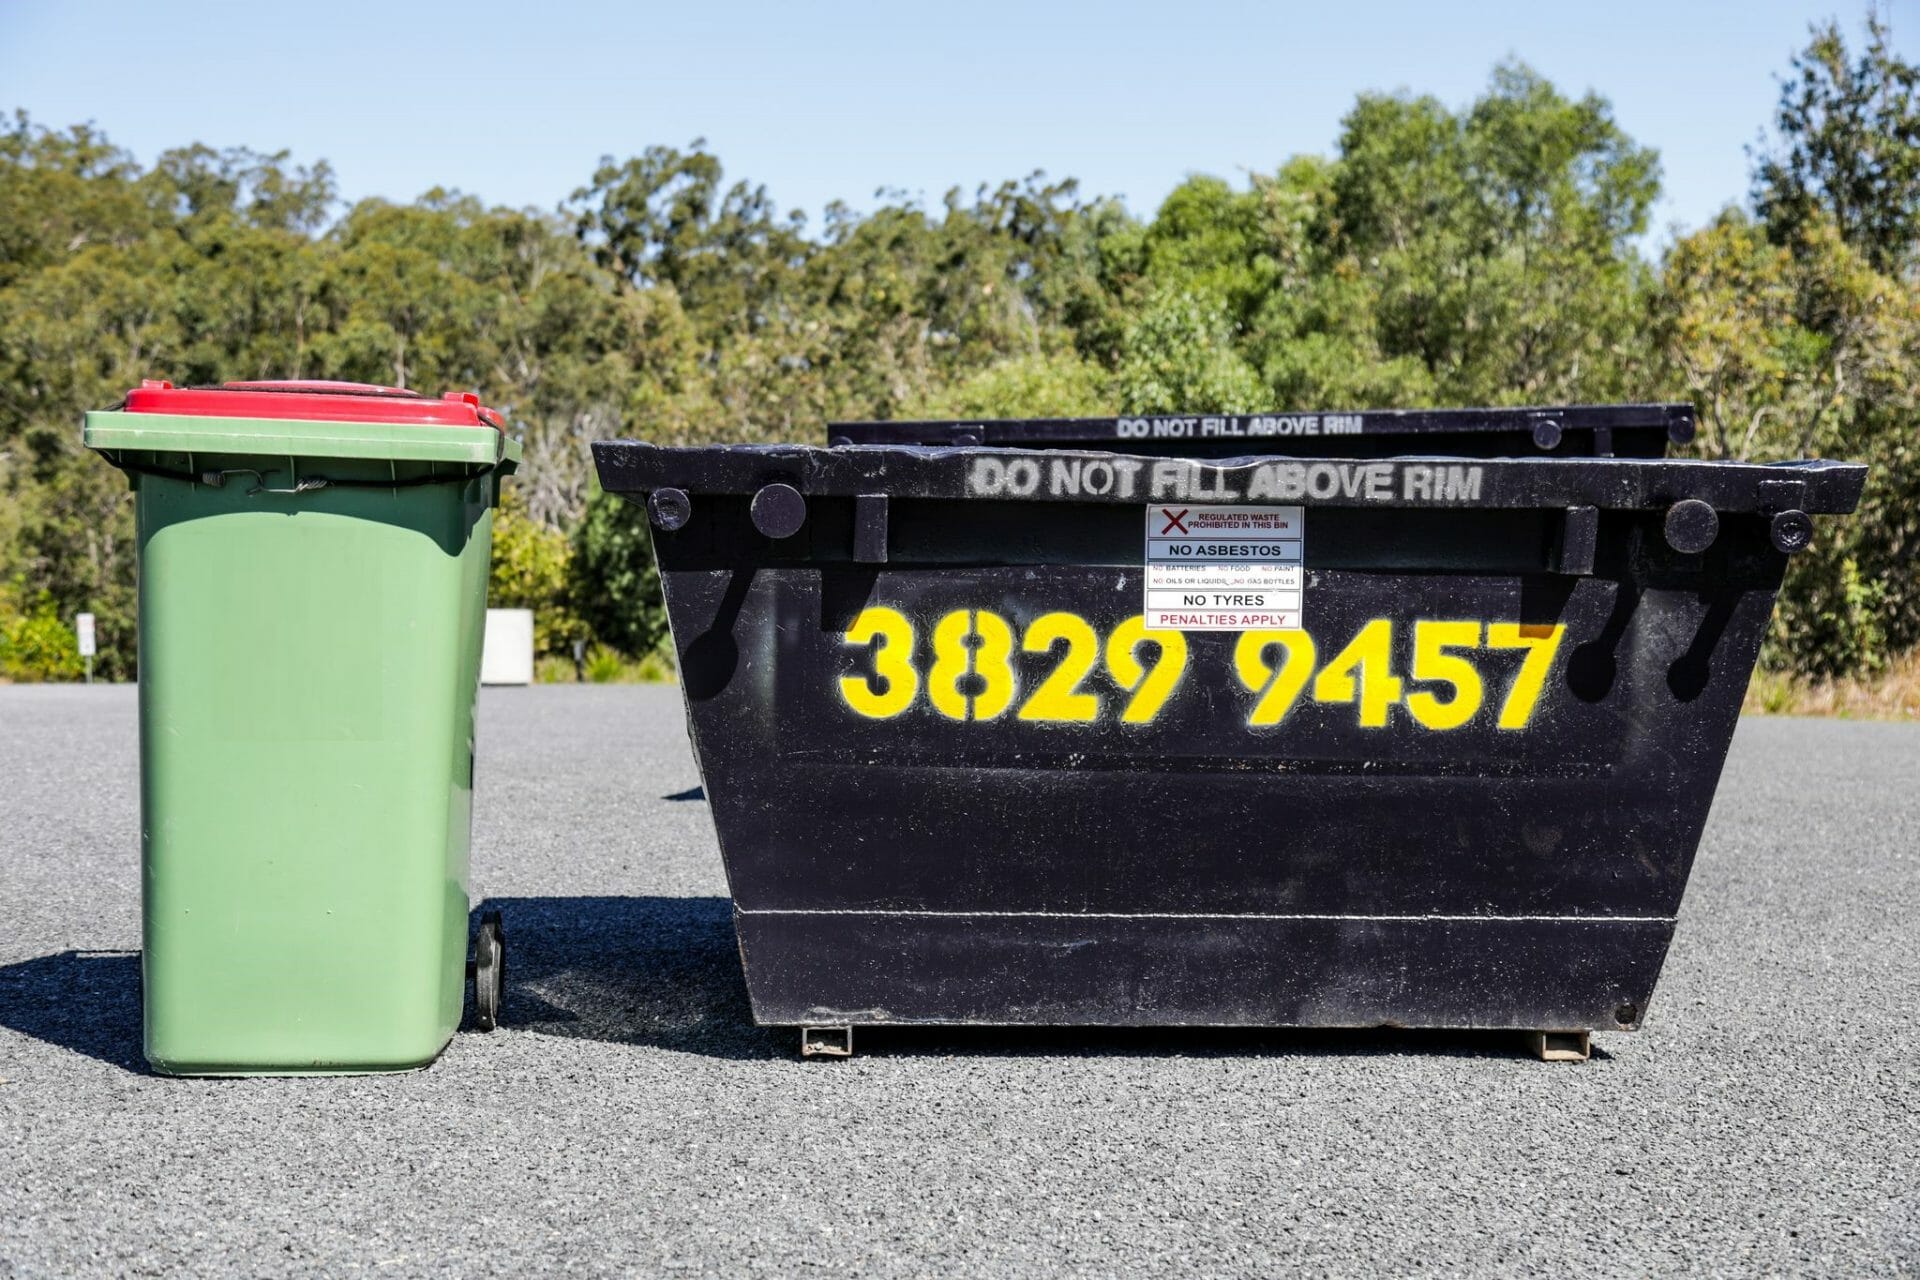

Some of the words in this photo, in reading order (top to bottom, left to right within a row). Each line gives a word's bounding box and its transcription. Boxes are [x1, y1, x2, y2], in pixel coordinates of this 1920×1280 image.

[1117, 419, 1149, 437] DO
[1153, 419, 1197, 437] NOT
[1201, 418, 1244, 436] FILL
[1247, 417, 1319, 435] ABOVE
[1323, 416, 1362, 434] RIM
[970, 457, 1039, 496] DO
[1051, 459, 1143, 498] NOT
[1153, 460, 1240, 499] FILL
[1249, 463, 1394, 500] ABOVE
[1404, 466, 1482, 500] RIM
[1188, 521, 1239, 529] PROHIBITED
[1169, 545, 1192, 556] NO
[1196, 545, 1281, 556] ASBESTOS
[1183, 595, 1206, 606] NO
[1213, 595, 1265, 606] TYRES
[1160, 615, 1237, 625] PENALTIES
[1241, 615, 1286, 625] APPLY
[839, 606, 1188, 725] 3829
[1233, 619, 1567, 730] 9457
